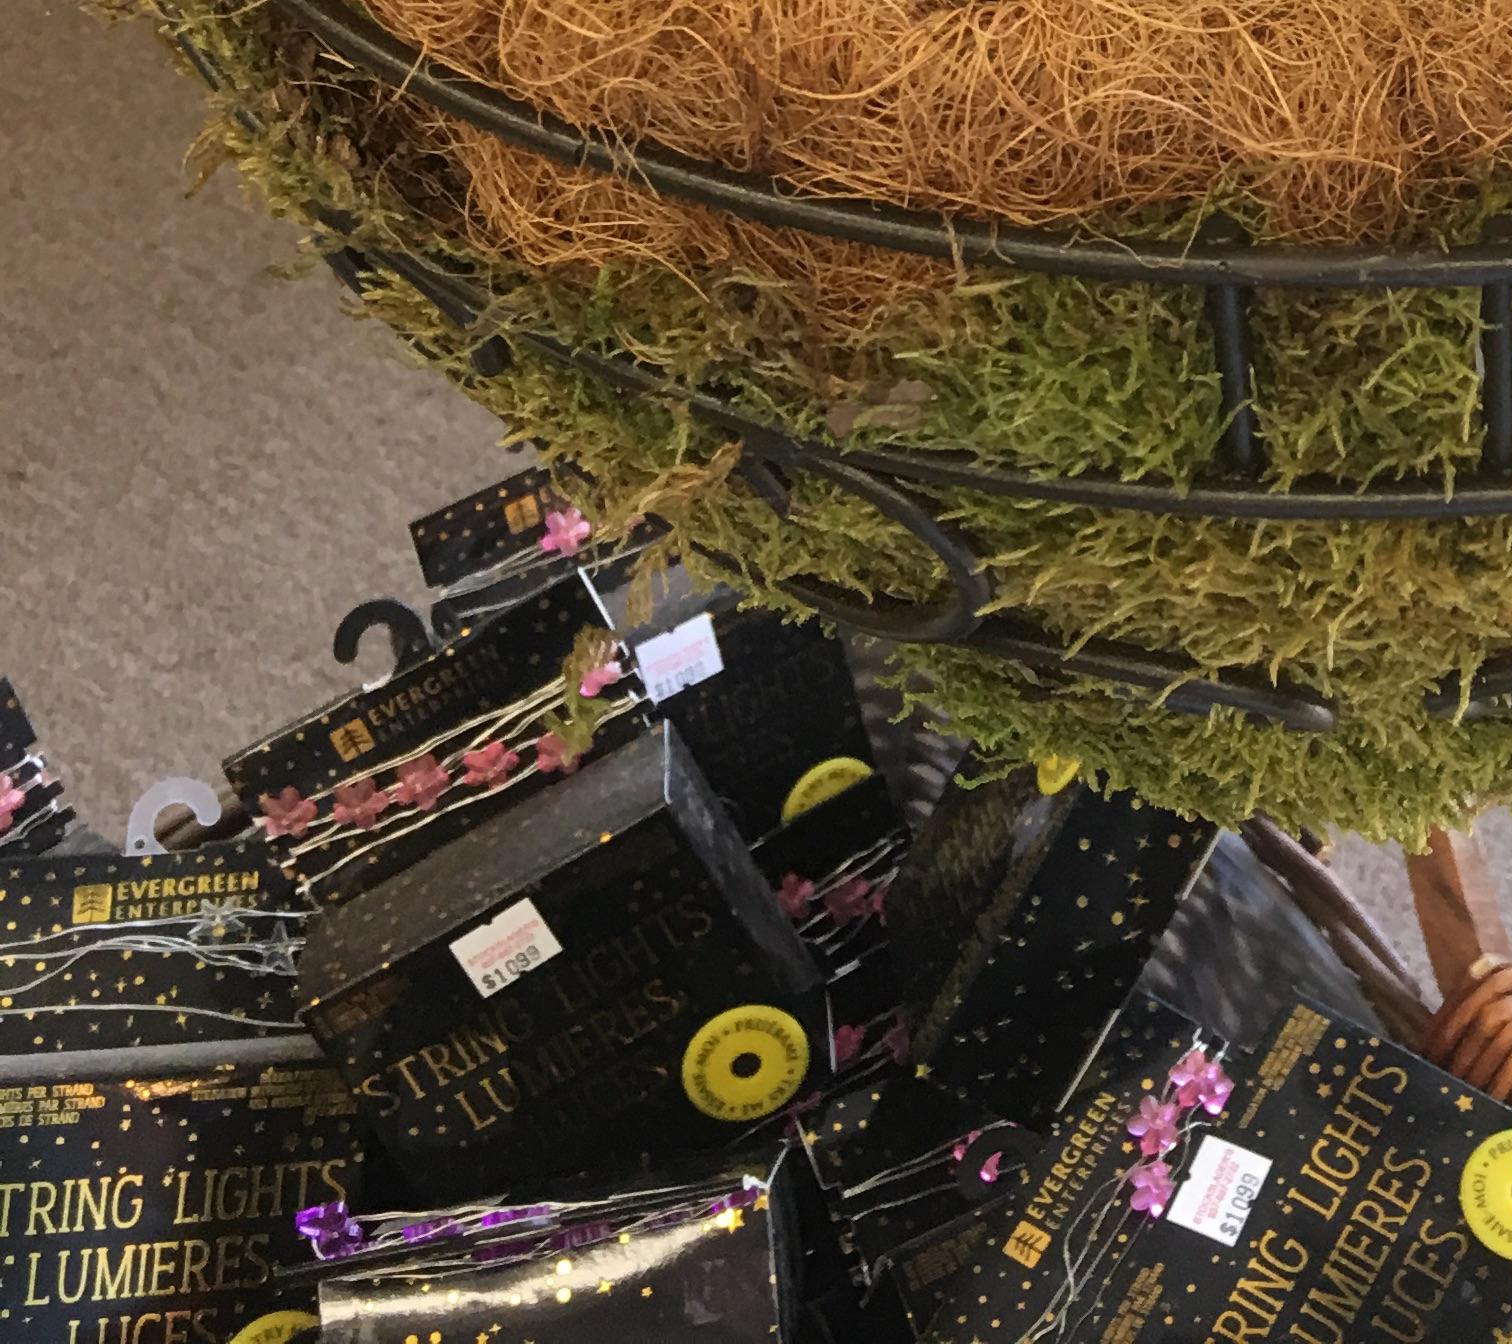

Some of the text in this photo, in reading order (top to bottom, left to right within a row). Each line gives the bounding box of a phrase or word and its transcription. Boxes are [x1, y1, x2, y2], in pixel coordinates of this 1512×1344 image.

[116, 870, 260, 902] EVERGREEN
[0, 1159, 347, 1238] TRING LIGHTS
[1025, 1091, 1117, 1220] EVERGREEN
[1044, 1100, 1132, 1231] ENTERPRISES
[1203, 1229, 1309, 1344] RING
[1286, 1054, 1408, 1220] LIGHTS
[24, 1233, 271, 1307] LUMIERES
[1290, 1146, 1432, 1344] UMIERES
[1372, 1218, 1470, 1342] UCES
